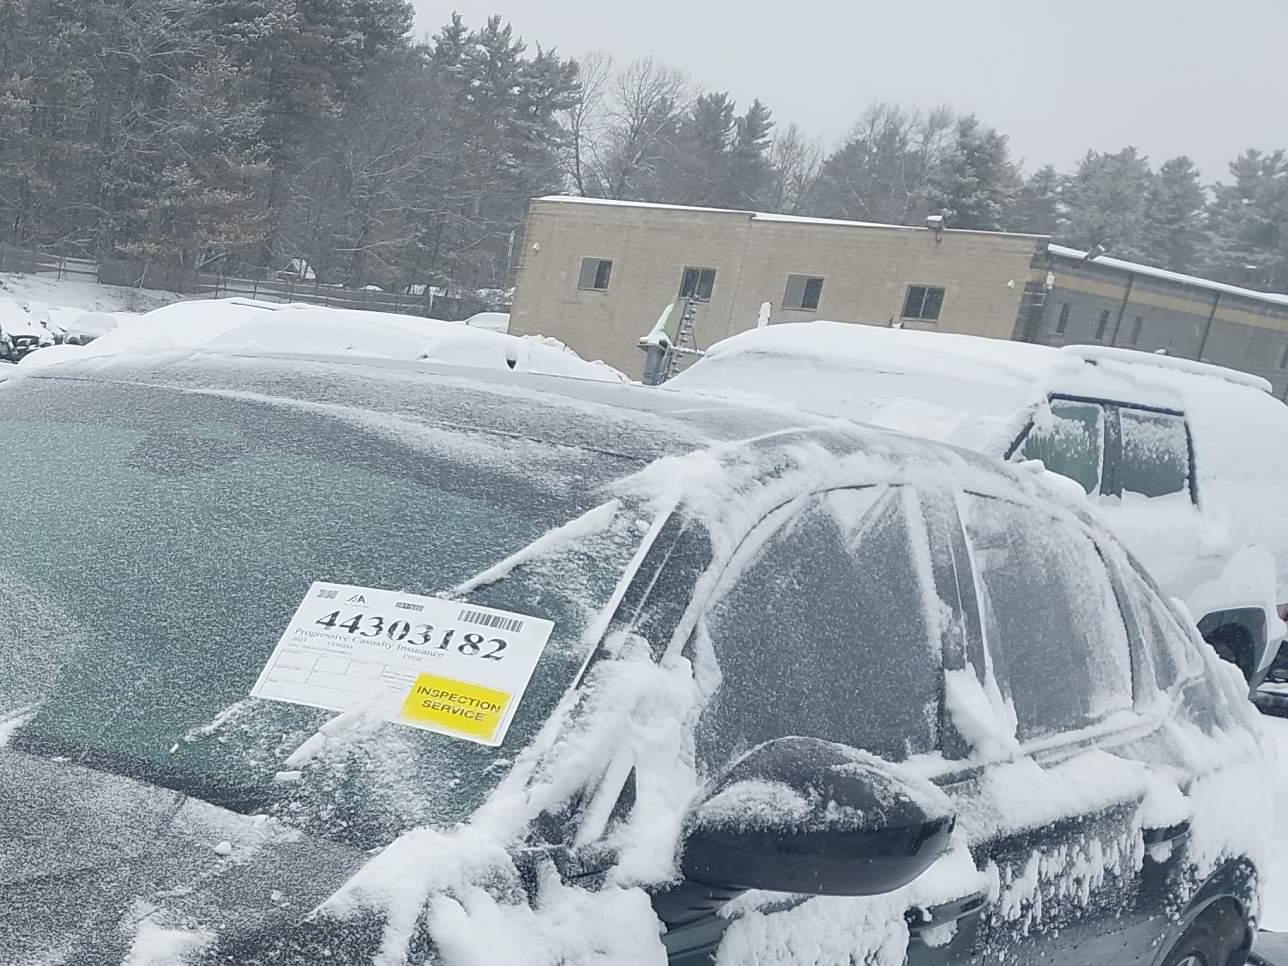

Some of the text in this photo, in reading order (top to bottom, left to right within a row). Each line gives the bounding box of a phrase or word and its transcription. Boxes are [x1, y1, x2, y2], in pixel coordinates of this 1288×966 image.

[295, 628, 350, 641] Progressive
[352, 635, 392, 650] Casualty
[396, 644, 445, 658] Insurance
[315, 610, 509, 661] 44303182
[416, 685, 502, 713] INSPECTION
[421, 699, 486, 722] SERVICE
